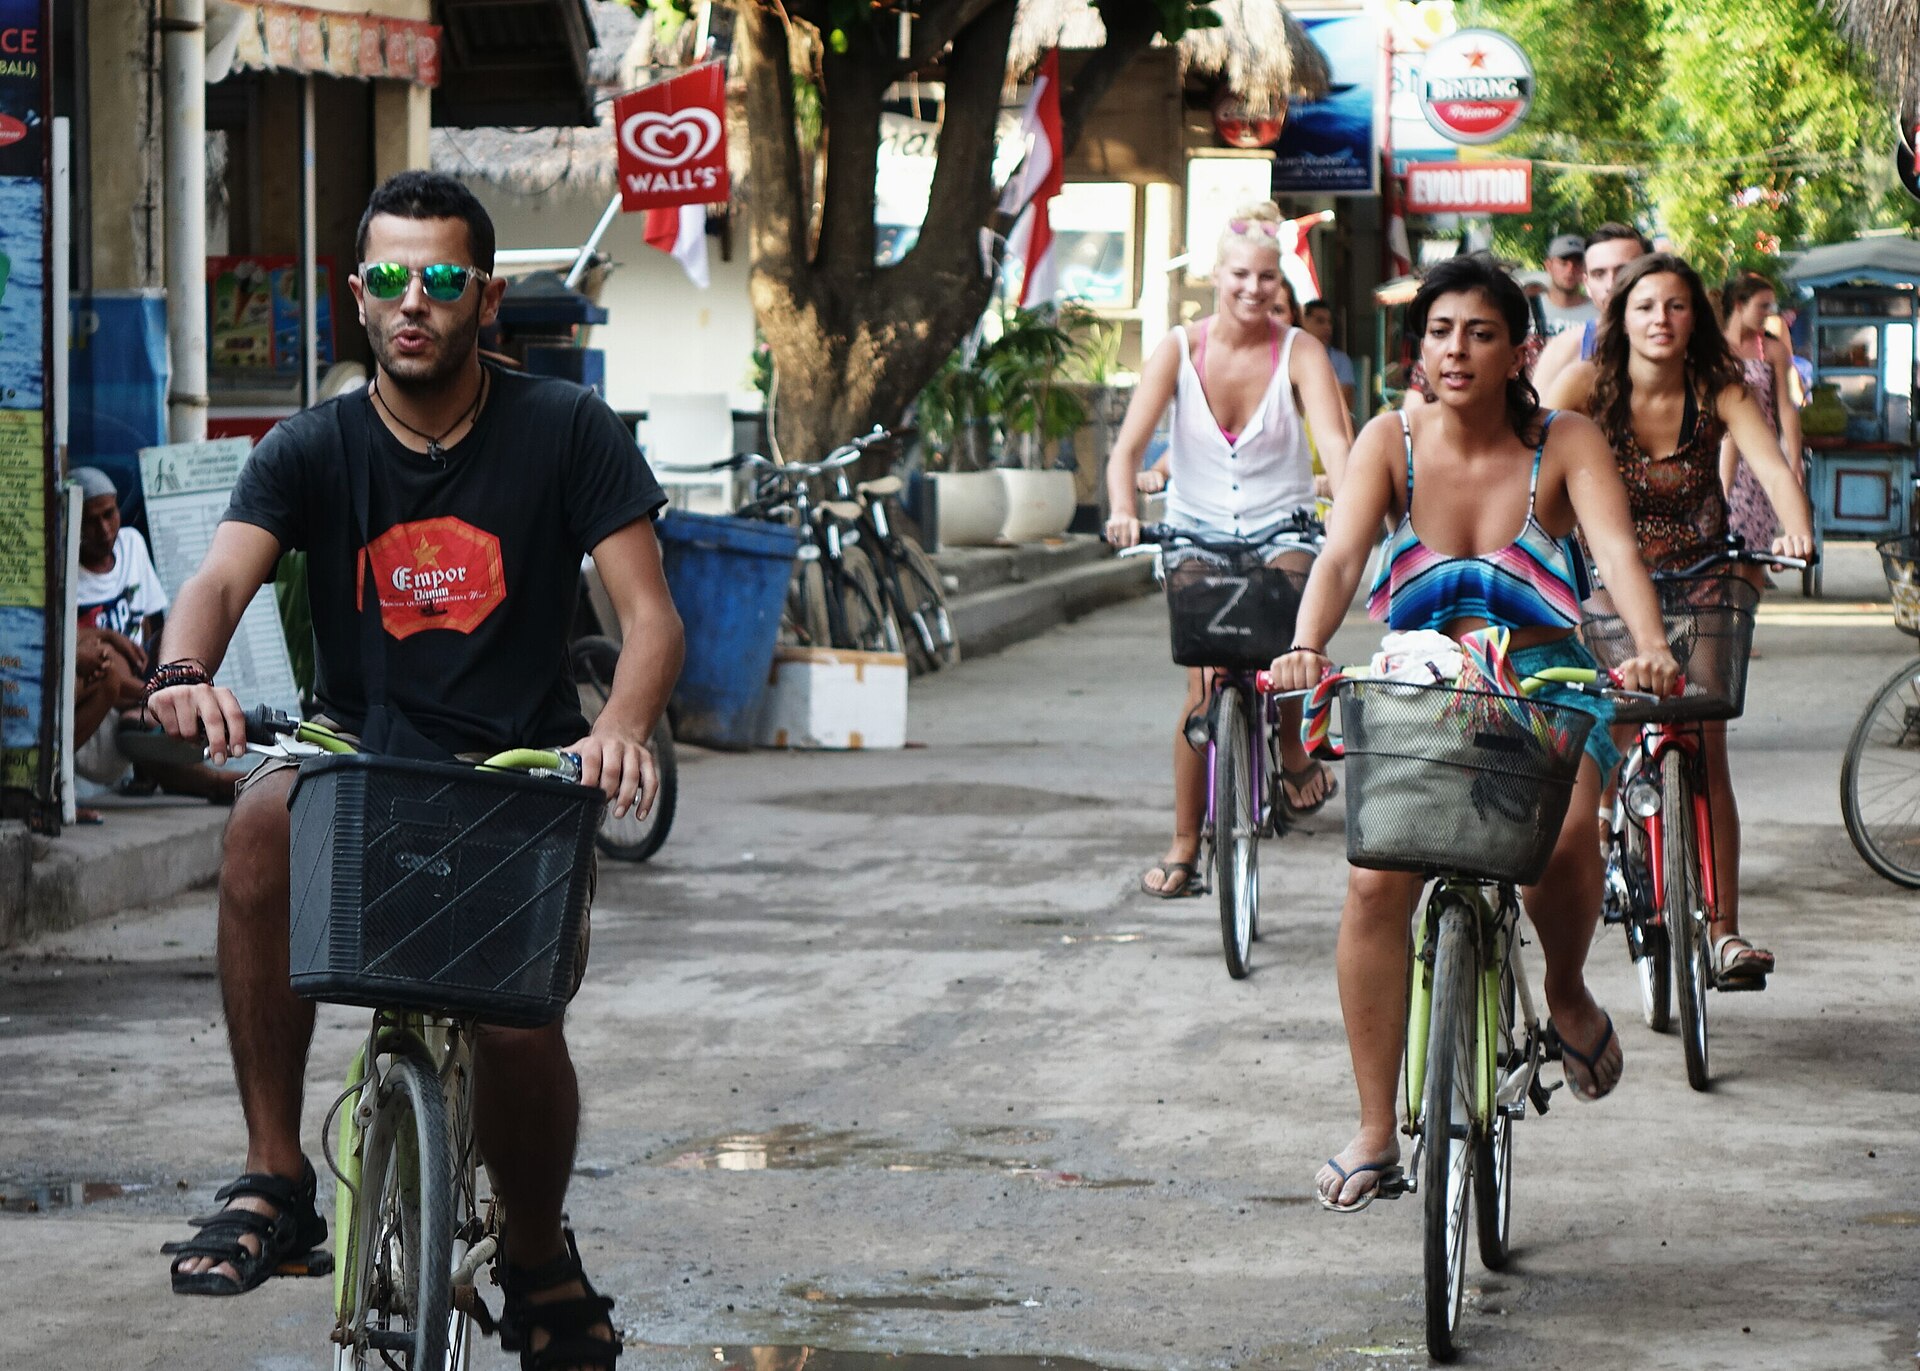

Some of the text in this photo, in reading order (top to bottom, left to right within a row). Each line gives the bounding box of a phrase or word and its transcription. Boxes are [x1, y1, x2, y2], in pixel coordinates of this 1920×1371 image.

[1428, 77, 1520, 98] BINTANG
[1410, 167, 1528, 206] EVOLUTION
[391, 565, 467, 592] Empor
